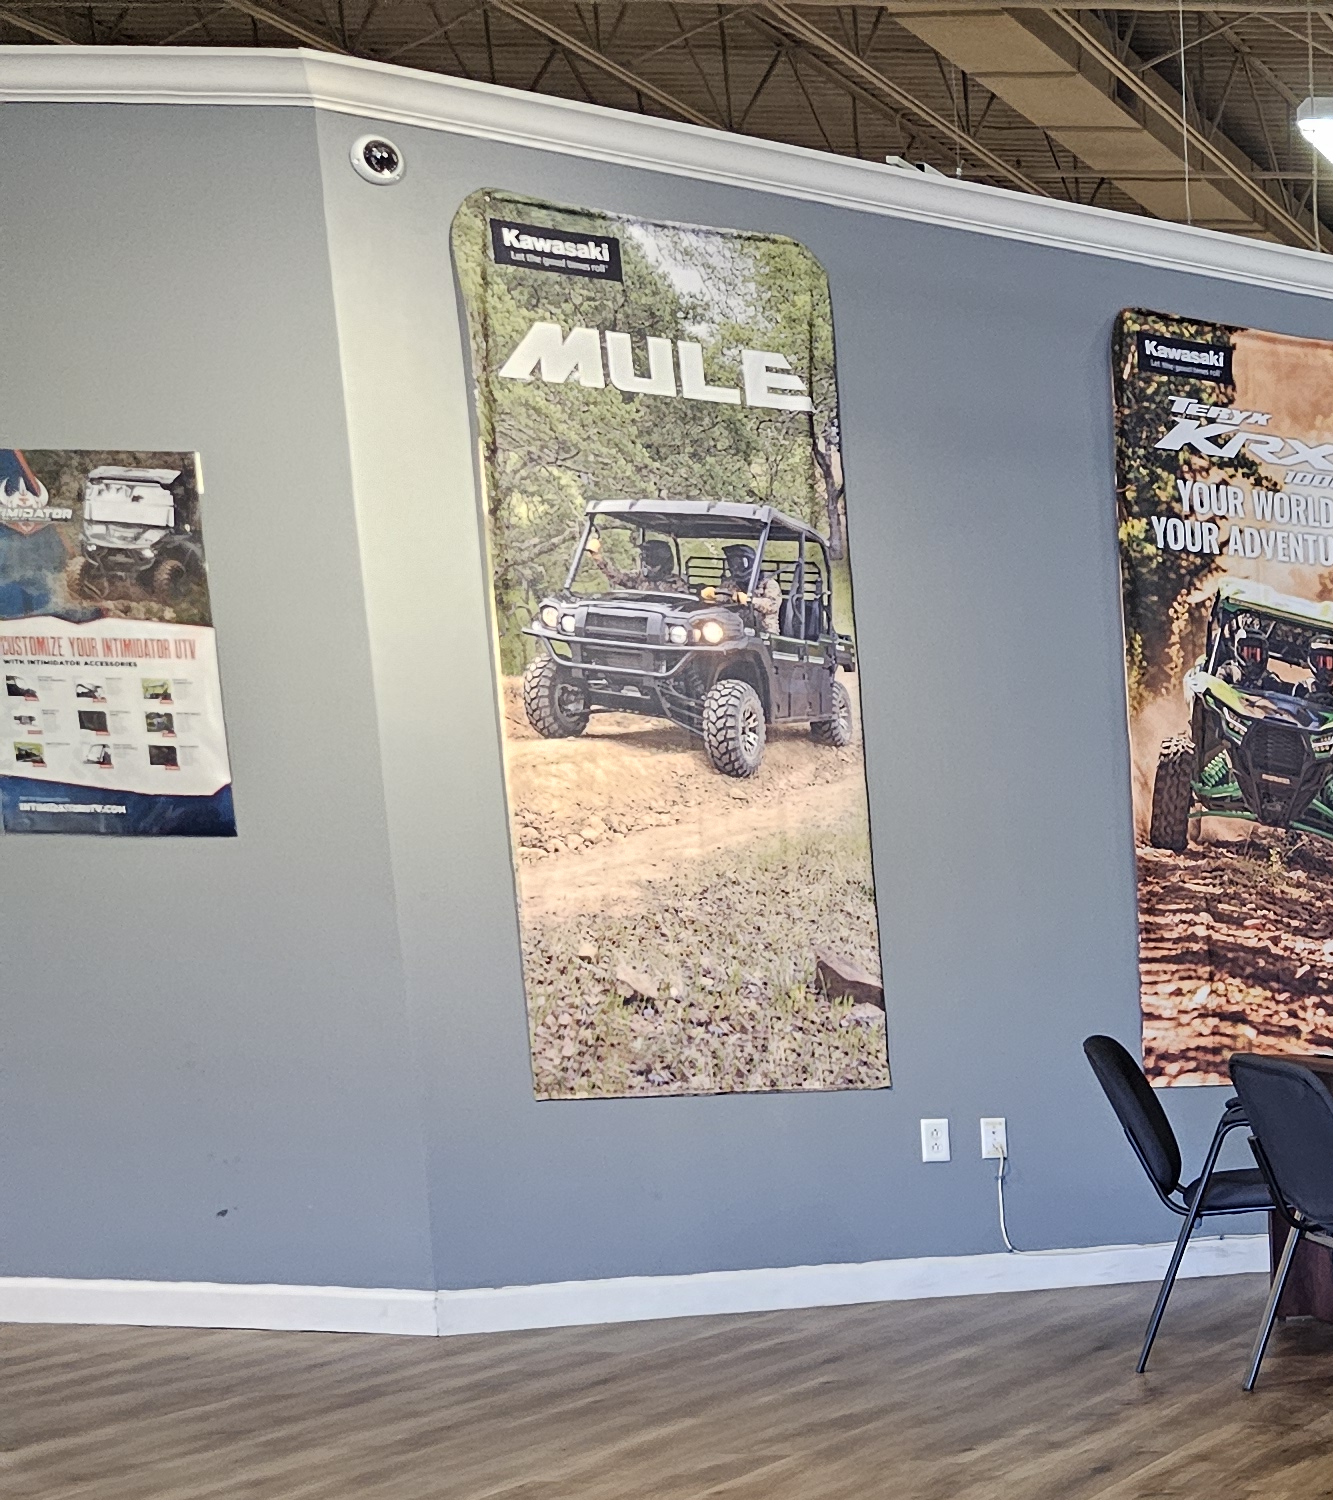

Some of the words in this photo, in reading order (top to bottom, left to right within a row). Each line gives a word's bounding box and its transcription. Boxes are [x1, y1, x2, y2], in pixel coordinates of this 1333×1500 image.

[501, 227, 610, 262] Kawasaki
[499, 321, 814, 412] MULE
[1144, 339, 1225, 368] Kawasaki
[1176, 478, 1245, 519] YOUR
[1150, 516, 1220, 555] YOUR
[0, 635, 65, 657] CUSTOMIZE
[68, 636, 99, 658] YOUR
[101, 637, 171, 660] INTIMIDATOR
[174, 638, 197, 660] UTV
[27, 658, 81, 667] INTIMIDATOR
[83, 660, 138, 668] ACCESSORIES
